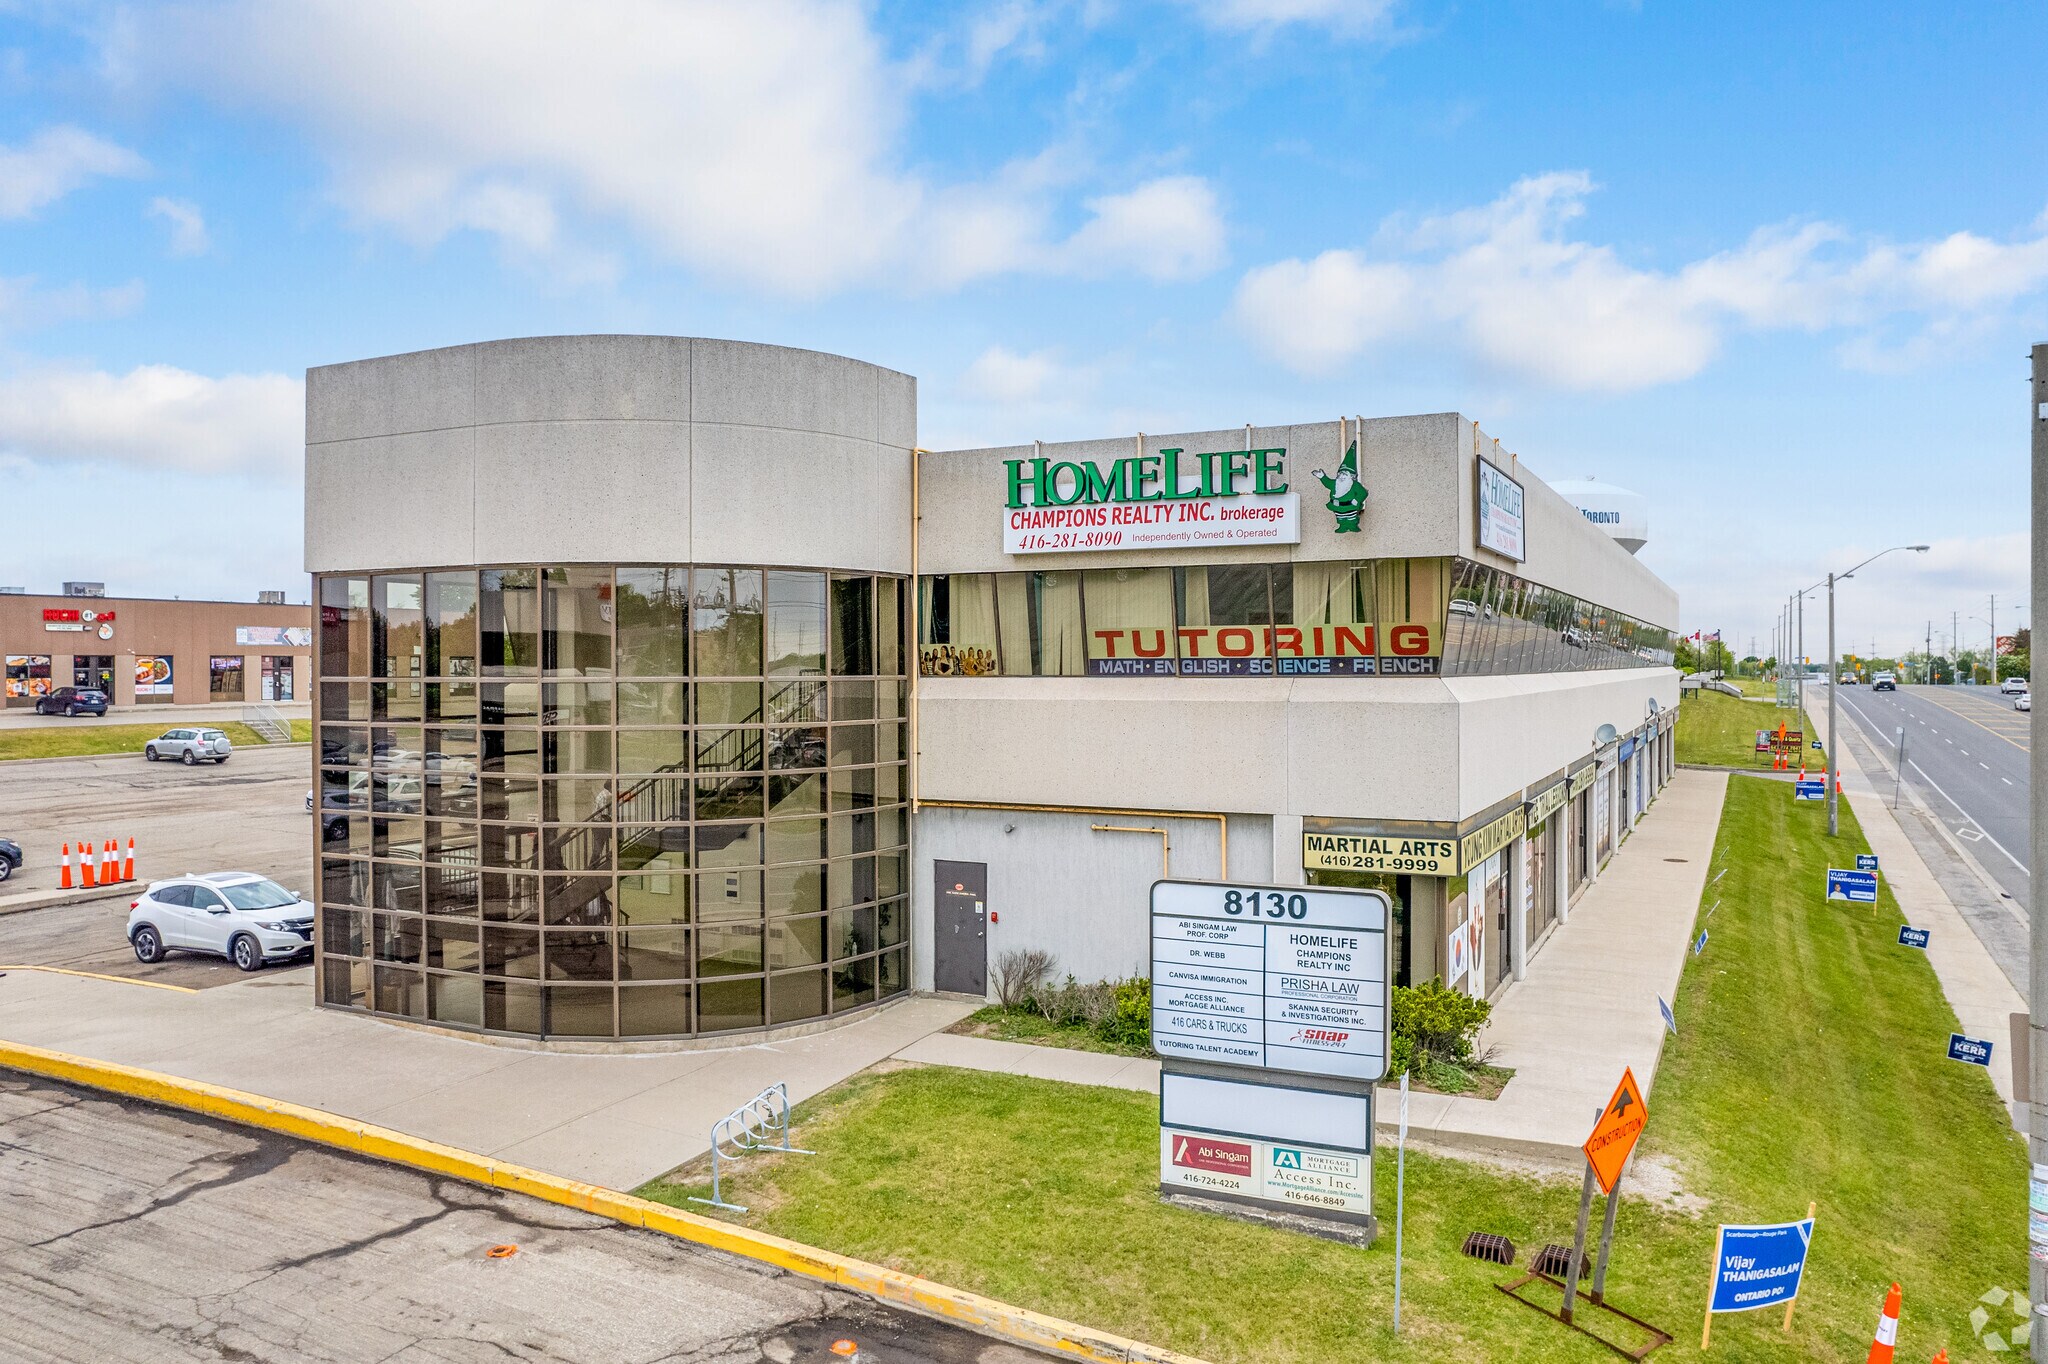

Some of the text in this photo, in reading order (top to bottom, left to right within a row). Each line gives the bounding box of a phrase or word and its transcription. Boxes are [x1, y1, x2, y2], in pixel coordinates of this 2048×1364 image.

[1010, 502, 1284, 530] CHAMPIONS REALTY INC. brokerage
[1581, 508, 1620, 524] TORONTO
[1018, 528, 1277, 550] 416-281-8090 Independently Owned & Operated
[1095, 624, 1430, 658] TUTORING
[1100, 658, 1434, 674] MATH ENGLISH SCIENCE FRENCH
[1308, 836, 1452, 858] MARTIAL ARTS
[1224, 890, 1308, 920] 8130
[1192, 922, 1220, 932] SINGAM
[1222, 924, 1238, 932] LAW
[1186, 930, 1229, 940] PROF. CORP
[1290, 934, 1358, 950] HOMELIFE
[1903, 932, 1926, 942] KERR
[1204, 951, 1226, 959] WEBB
[1296, 950, 1352, 962] CHAMPIONS
[1297, 960, 1350, 972] REALTY INC
[1168, 972, 1248, 986] CANVISA IMMIGRATION
[1281, 978, 1360, 994] PRISHA LAW
[1184, 993, 1212, 1002] ACCESS
[1281, 990, 1358, 1002] PROFESSIONAL CORPORATION
[1168, 1000, 1245, 1014] MORTGAGE ALLIANCE
[1288, 1004, 1358, 1016] SKANNA SECURITY
[1172, 1016, 1248, 1034] 416 CARS & TRUCKS
[1288, 1011, 1350, 1024] INVESTIGATIONS
[1352, 1017, 1366, 1026] INC.
[1304, 1028, 1349, 1042] snap
[1160, 1040, 1258, 1057] TUTORING TALENT ACADEMY
[1954, 1042, 1986, 1056] KERR
[1591, 1118, 1642, 1152] CONSTRUCTION
[1215, 1148, 1249, 1162] Singam
[1308, 1156, 1350, 1166] MORTGAGE
[1307, 1163, 1350, 1173] ALLIANCE
[1183, 1173, 1240, 1189] 416-724-4224
[1274, 1168, 1356, 1190] Access Inc.
[1284, 1190, 1346, 1206] 416-646-8849
[1725, 1256, 1756, 1270] Vijay
[1722, 1262, 1800, 1282] THANIGASALAM
[1734, 1288, 1770, 1302] ONTARIO
